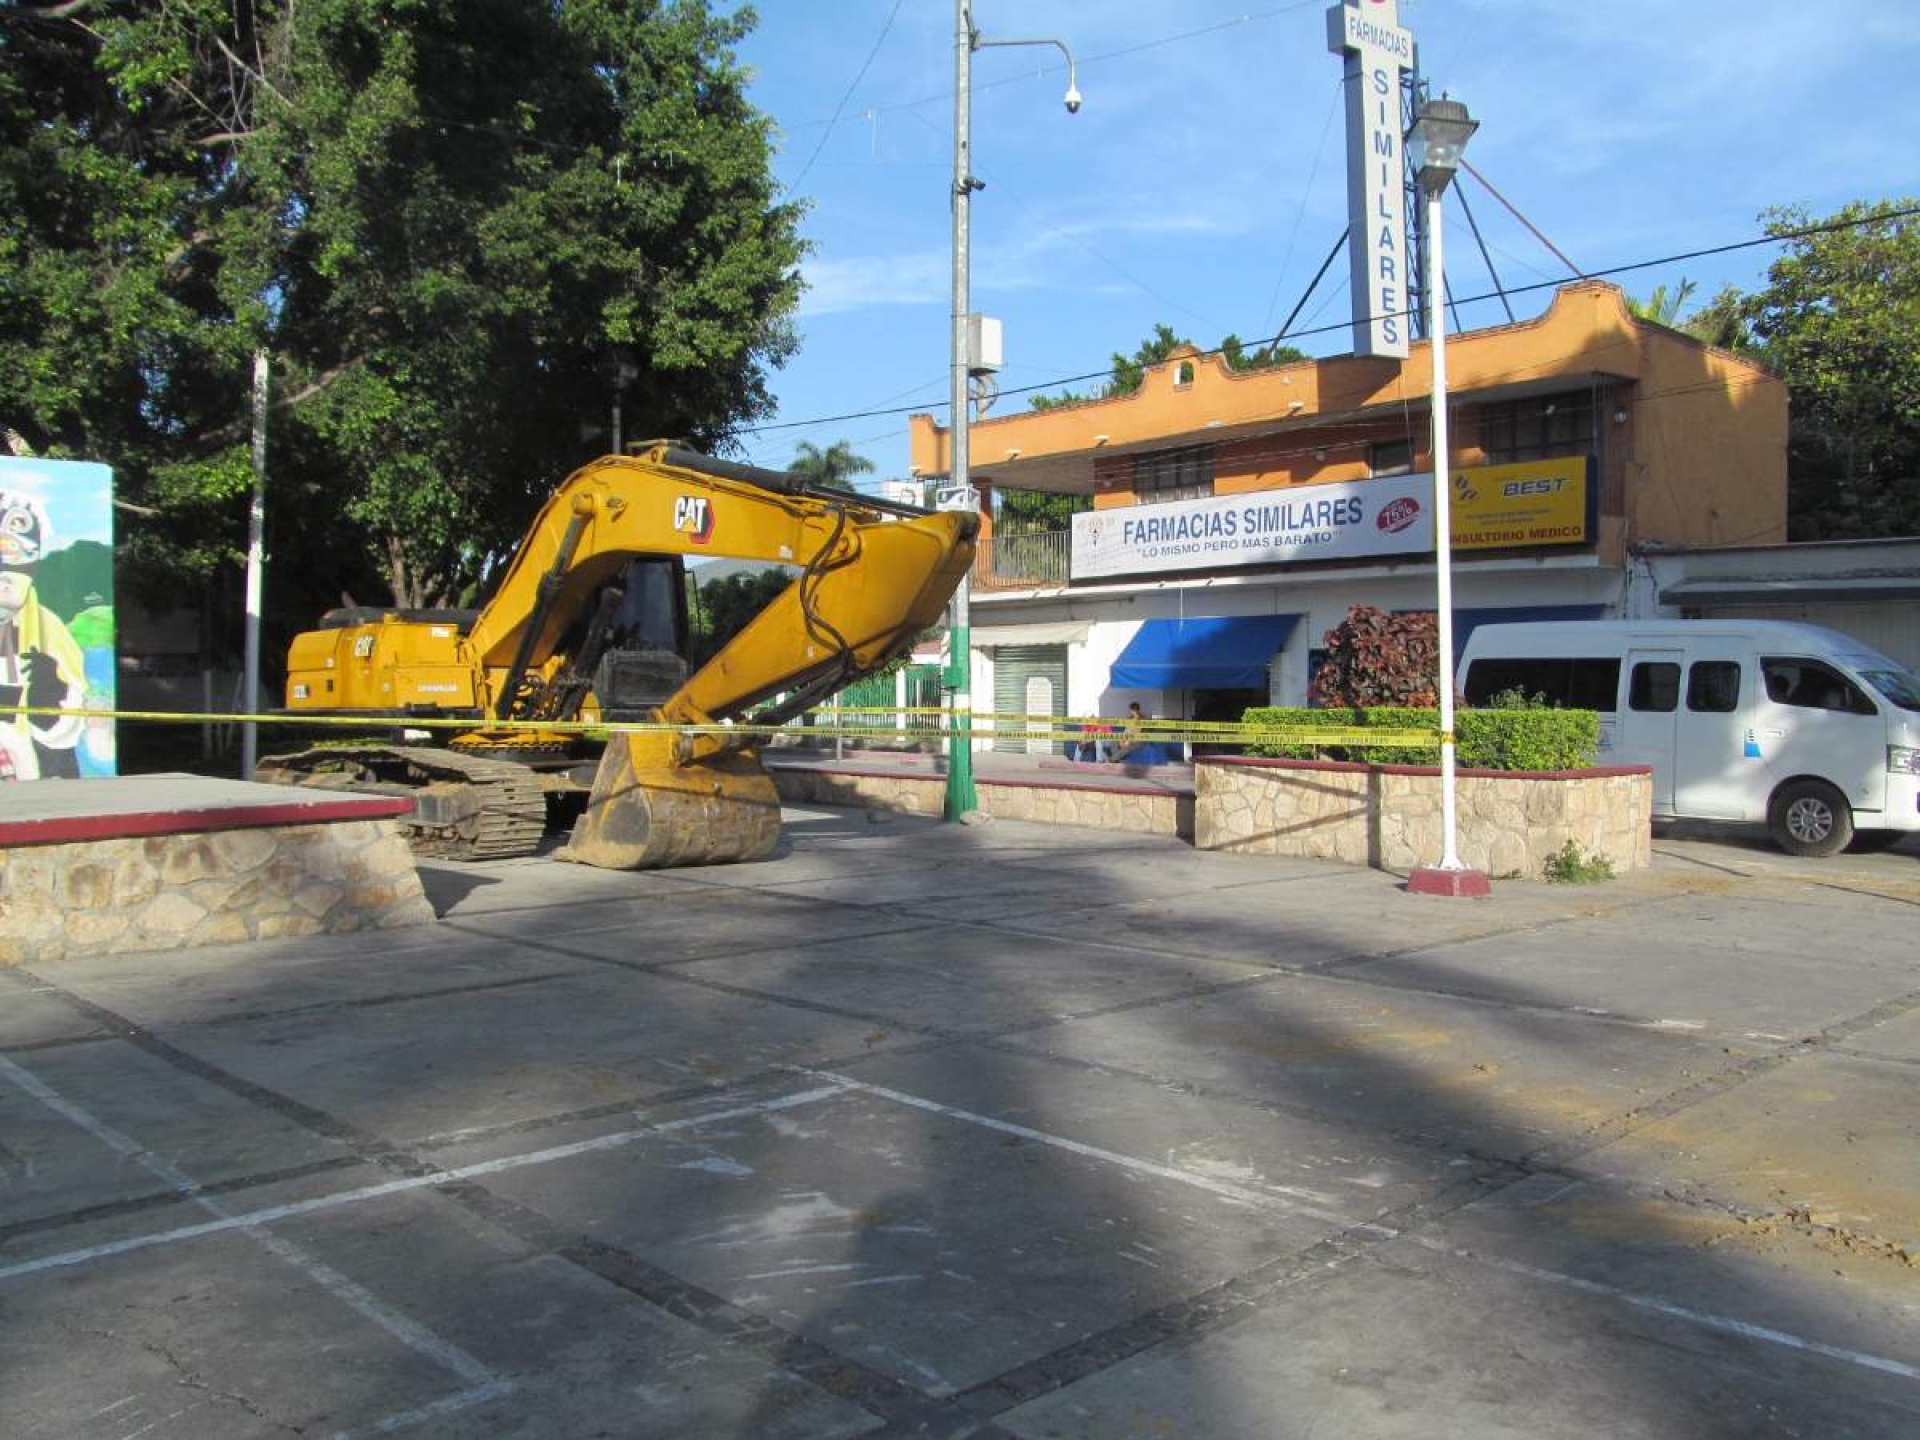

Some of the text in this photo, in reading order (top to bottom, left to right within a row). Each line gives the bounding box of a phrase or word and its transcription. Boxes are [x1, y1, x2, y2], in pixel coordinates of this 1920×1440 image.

[1349, 16, 1409, 58] FARMACIAS
[1373, 69, 1399, 345] SIMILARES
[1503, 478, 1566, 497] BEST
[674, 497, 707, 533] CAT
[1123, 496, 1363, 545] FARMACIAS SIMILARES
[1528, 526, 1582, 539] MEDICO
[1161, 542, 1201, 556] MISMO
[1204, 539, 1238, 551] PERO
